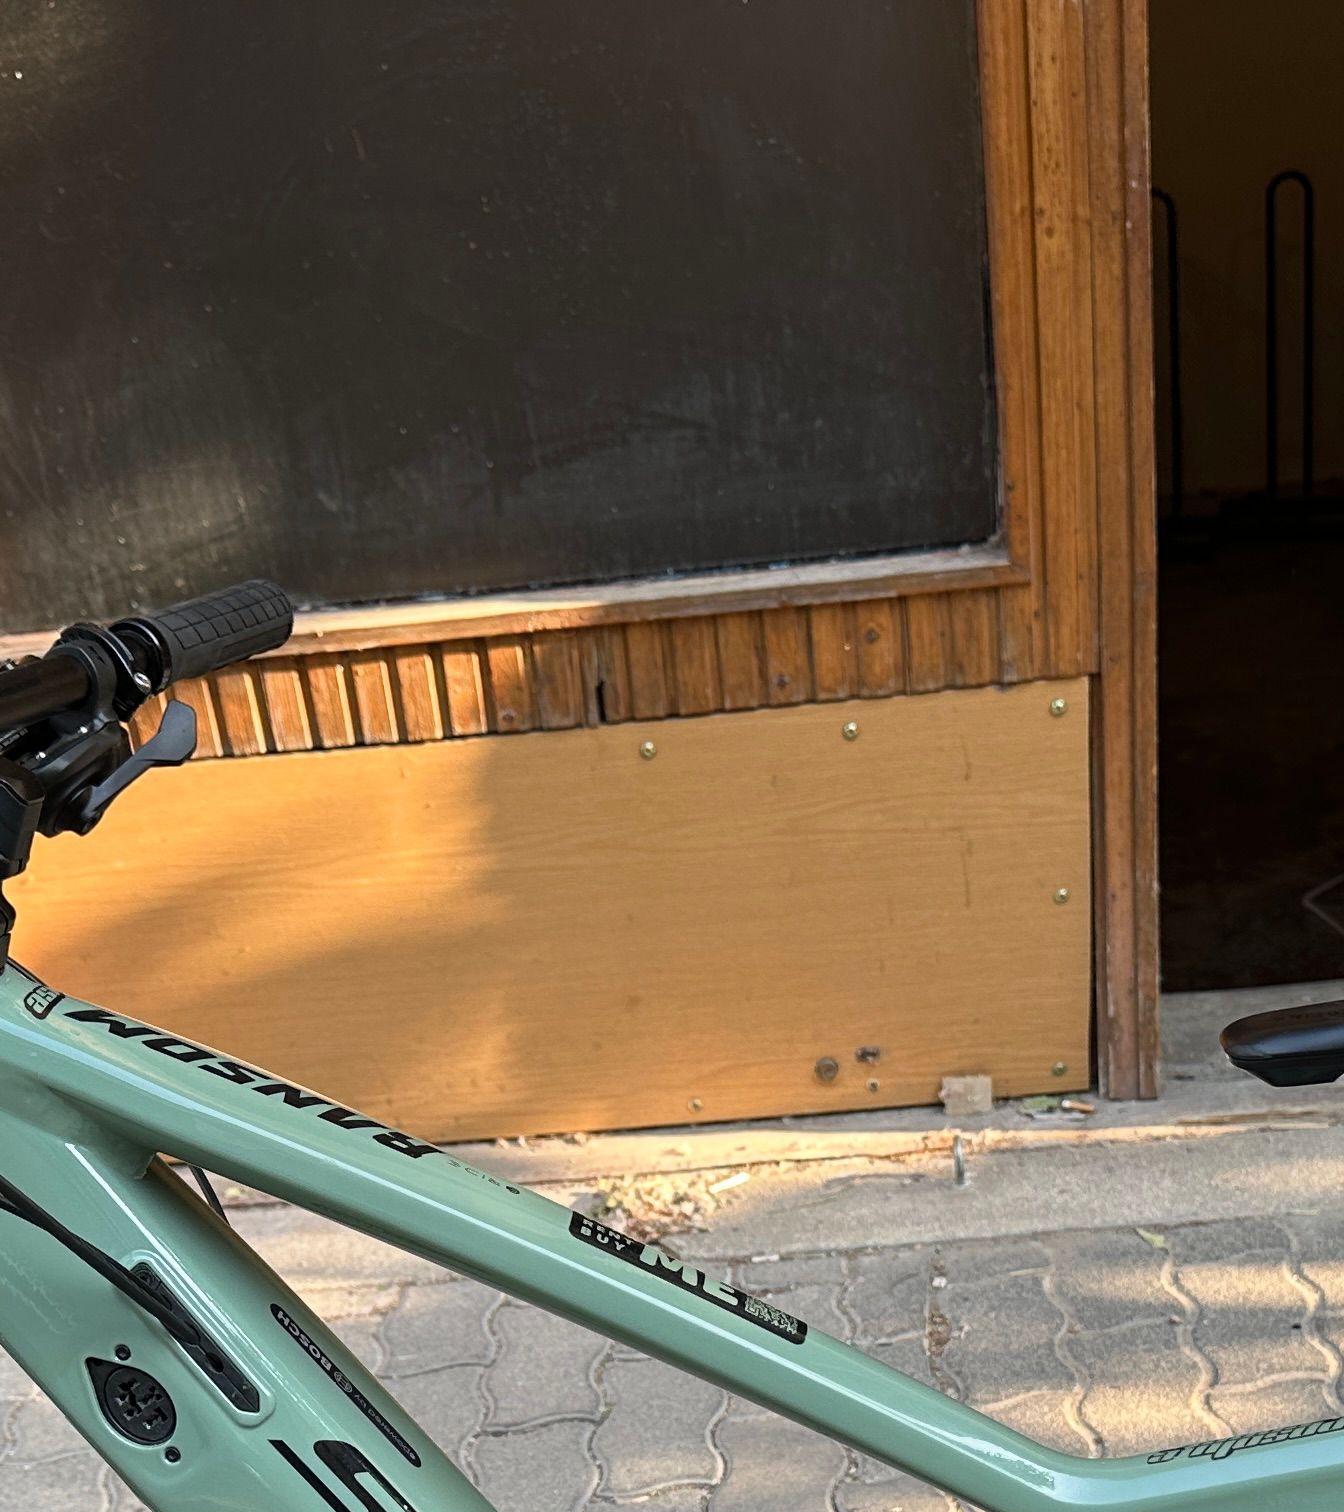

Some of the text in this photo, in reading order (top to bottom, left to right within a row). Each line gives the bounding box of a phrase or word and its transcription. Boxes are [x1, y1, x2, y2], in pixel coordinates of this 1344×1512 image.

[63, 1008, 445, 1160] RANSOM
[639, 1244, 738, 1306] ME
[274, 1309, 333, 1372] BOSCH
